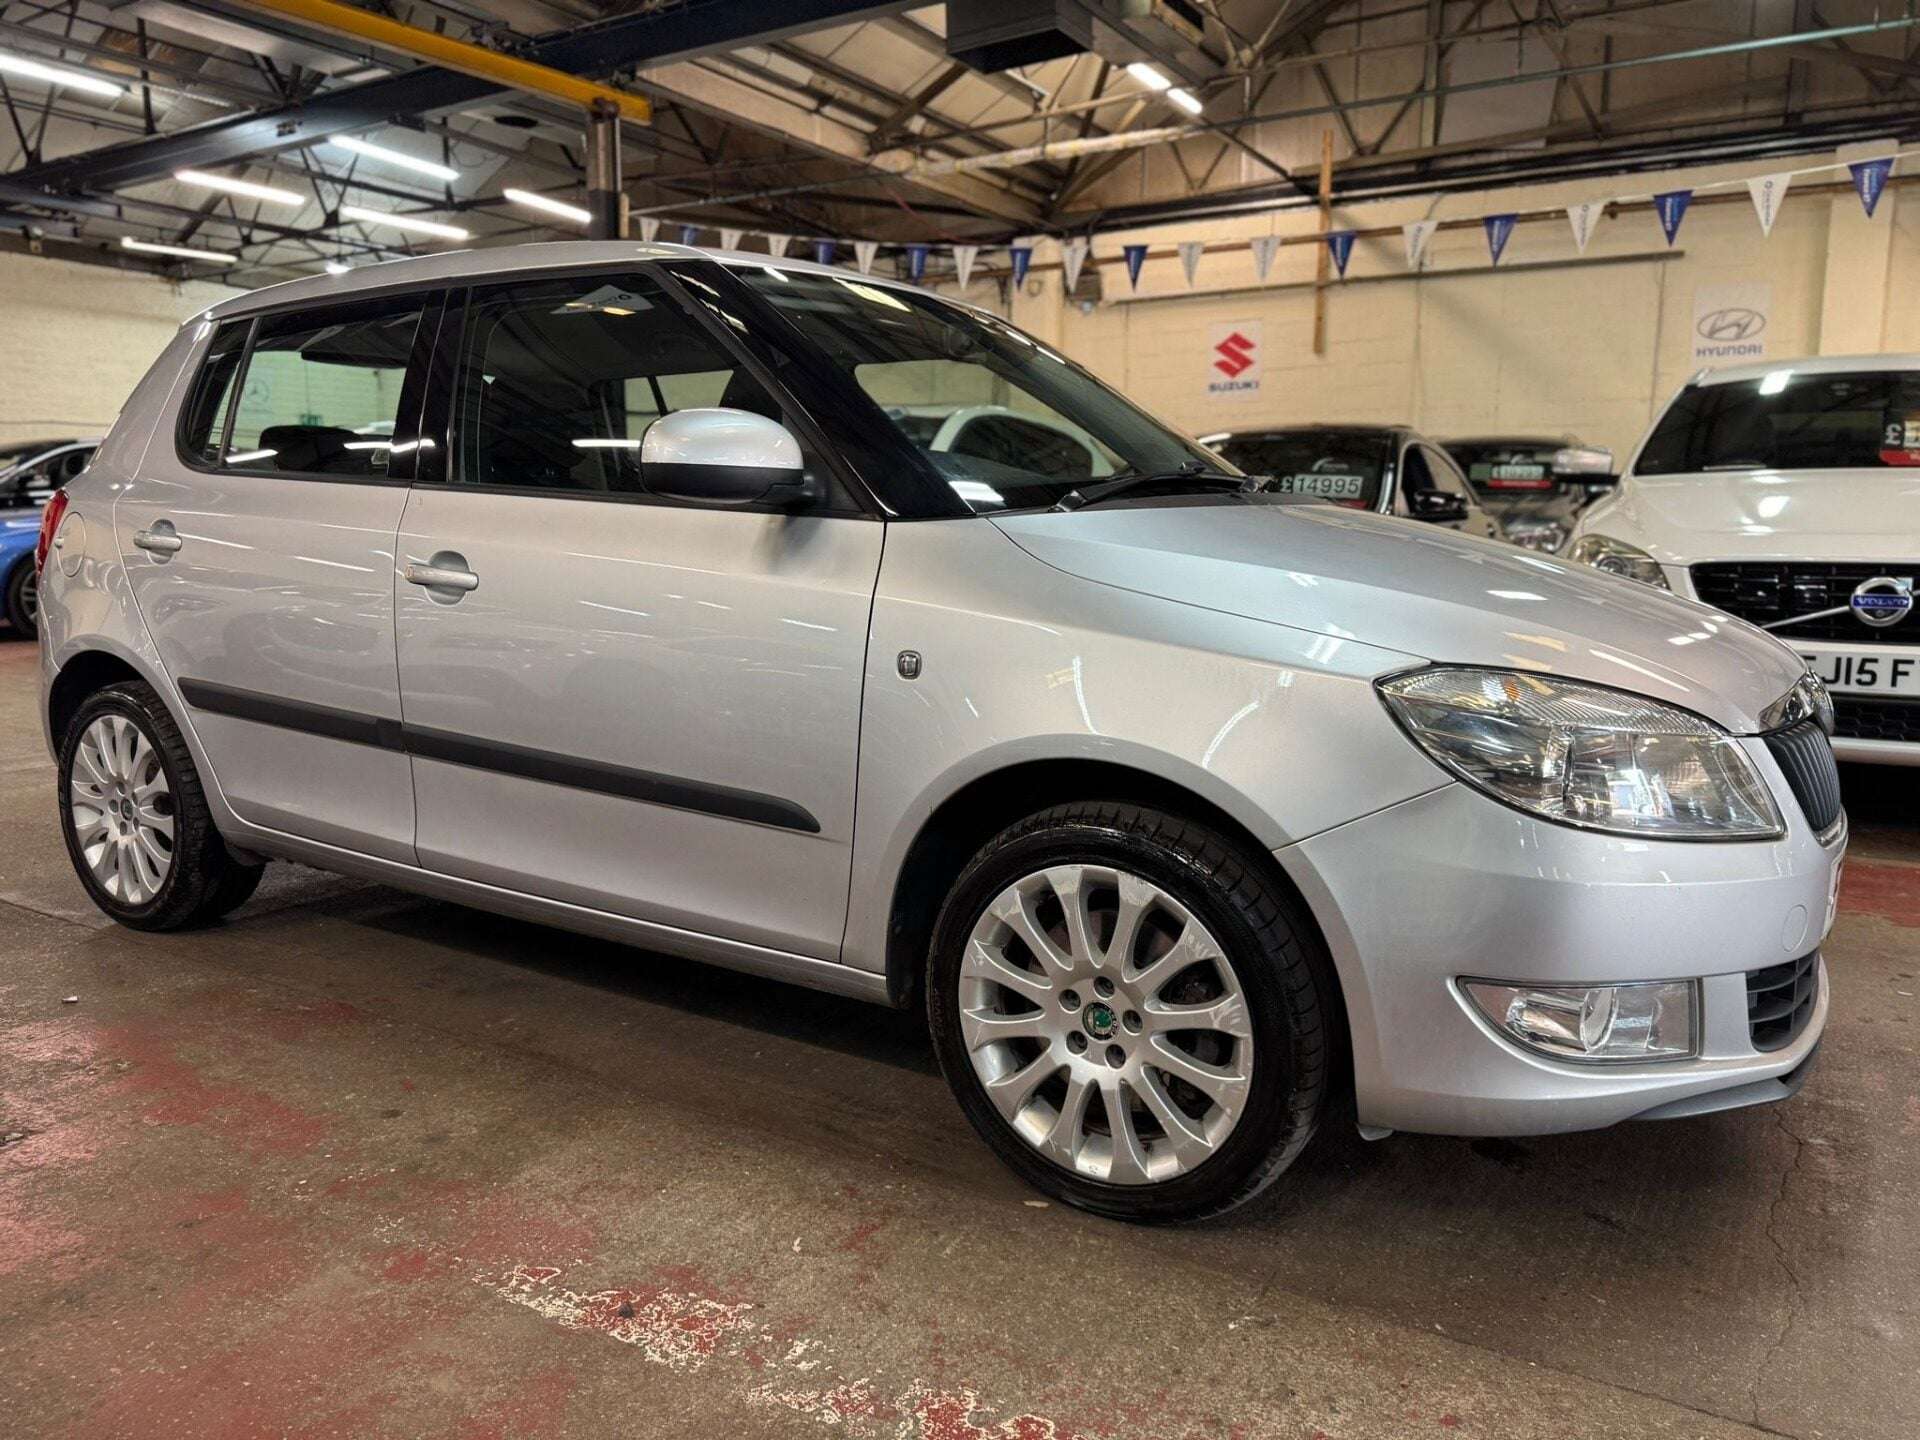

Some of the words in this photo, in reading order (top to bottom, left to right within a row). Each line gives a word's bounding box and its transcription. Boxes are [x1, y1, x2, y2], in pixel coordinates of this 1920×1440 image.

[1696, 345, 1763, 357] HYUNDAI
[1208, 381, 1259, 393] SUZUKI
[1281, 476, 1360, 494] £14995
[1856, 596, 1908, 606] VOLVO
